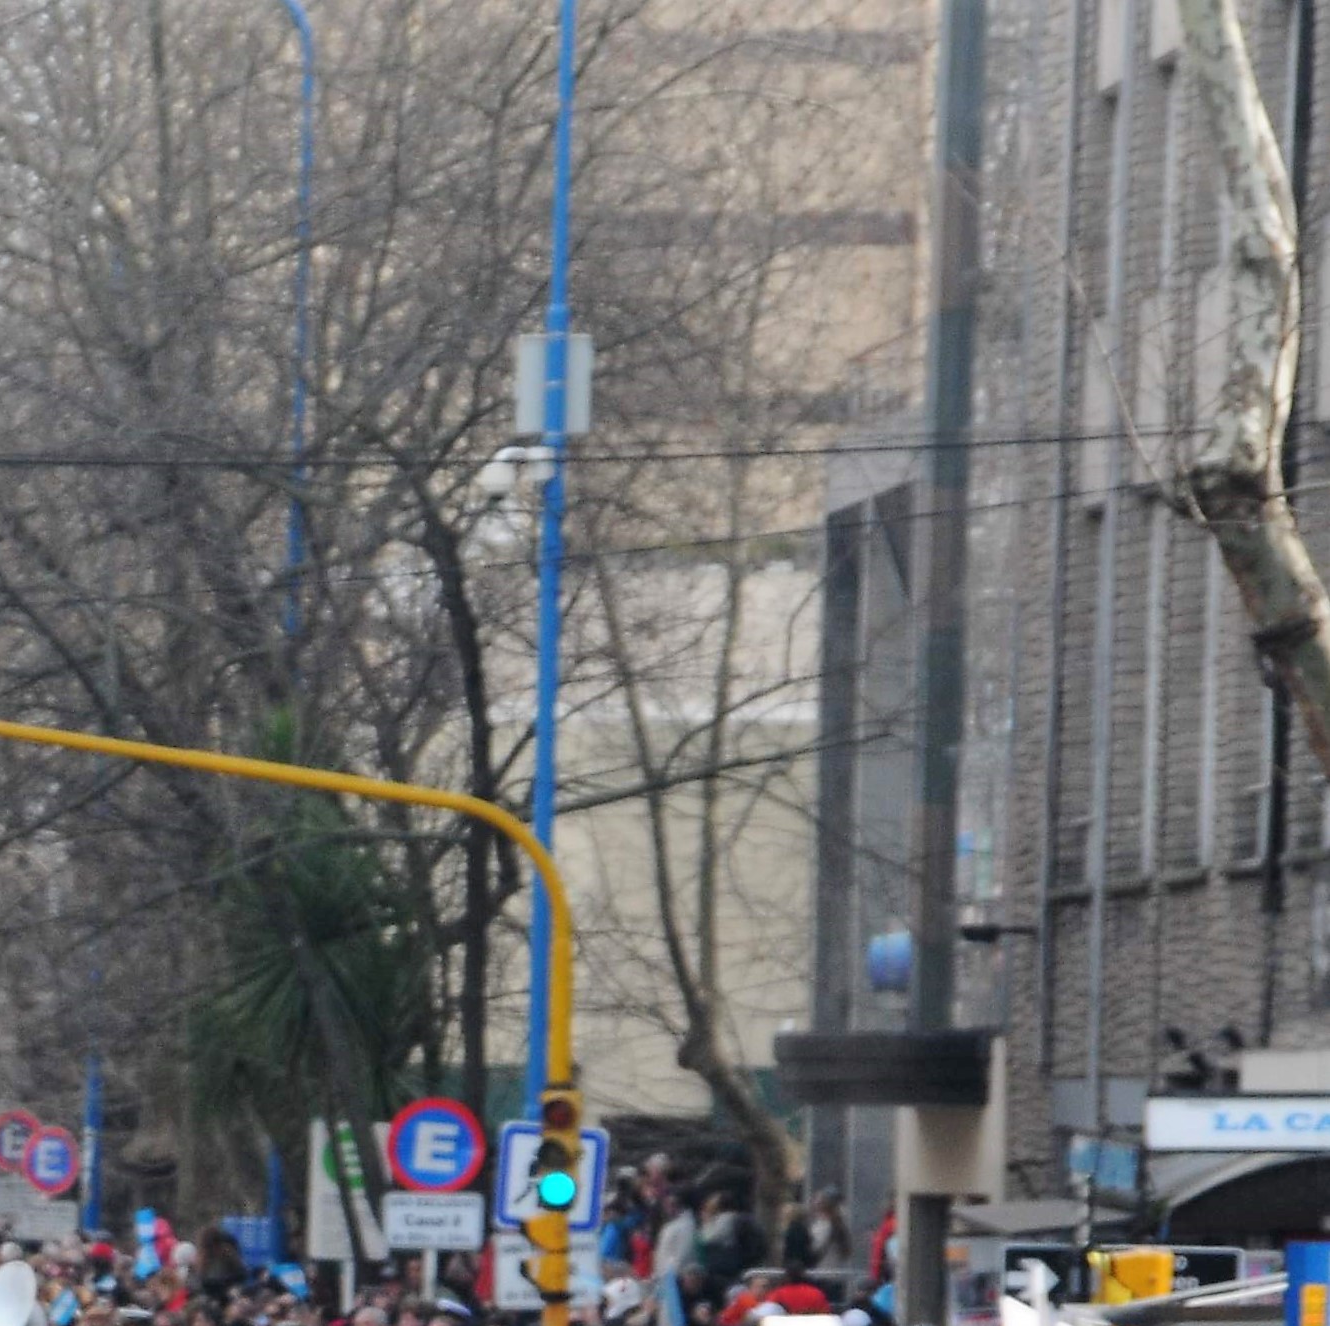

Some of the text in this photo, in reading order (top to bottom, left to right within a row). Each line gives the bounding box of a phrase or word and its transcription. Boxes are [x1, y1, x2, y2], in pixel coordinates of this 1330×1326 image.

[1214, 1113, 1272, 1130] LA
[35, 1138, 66, 1179] E
[412, 1120, 460, 1172] E
